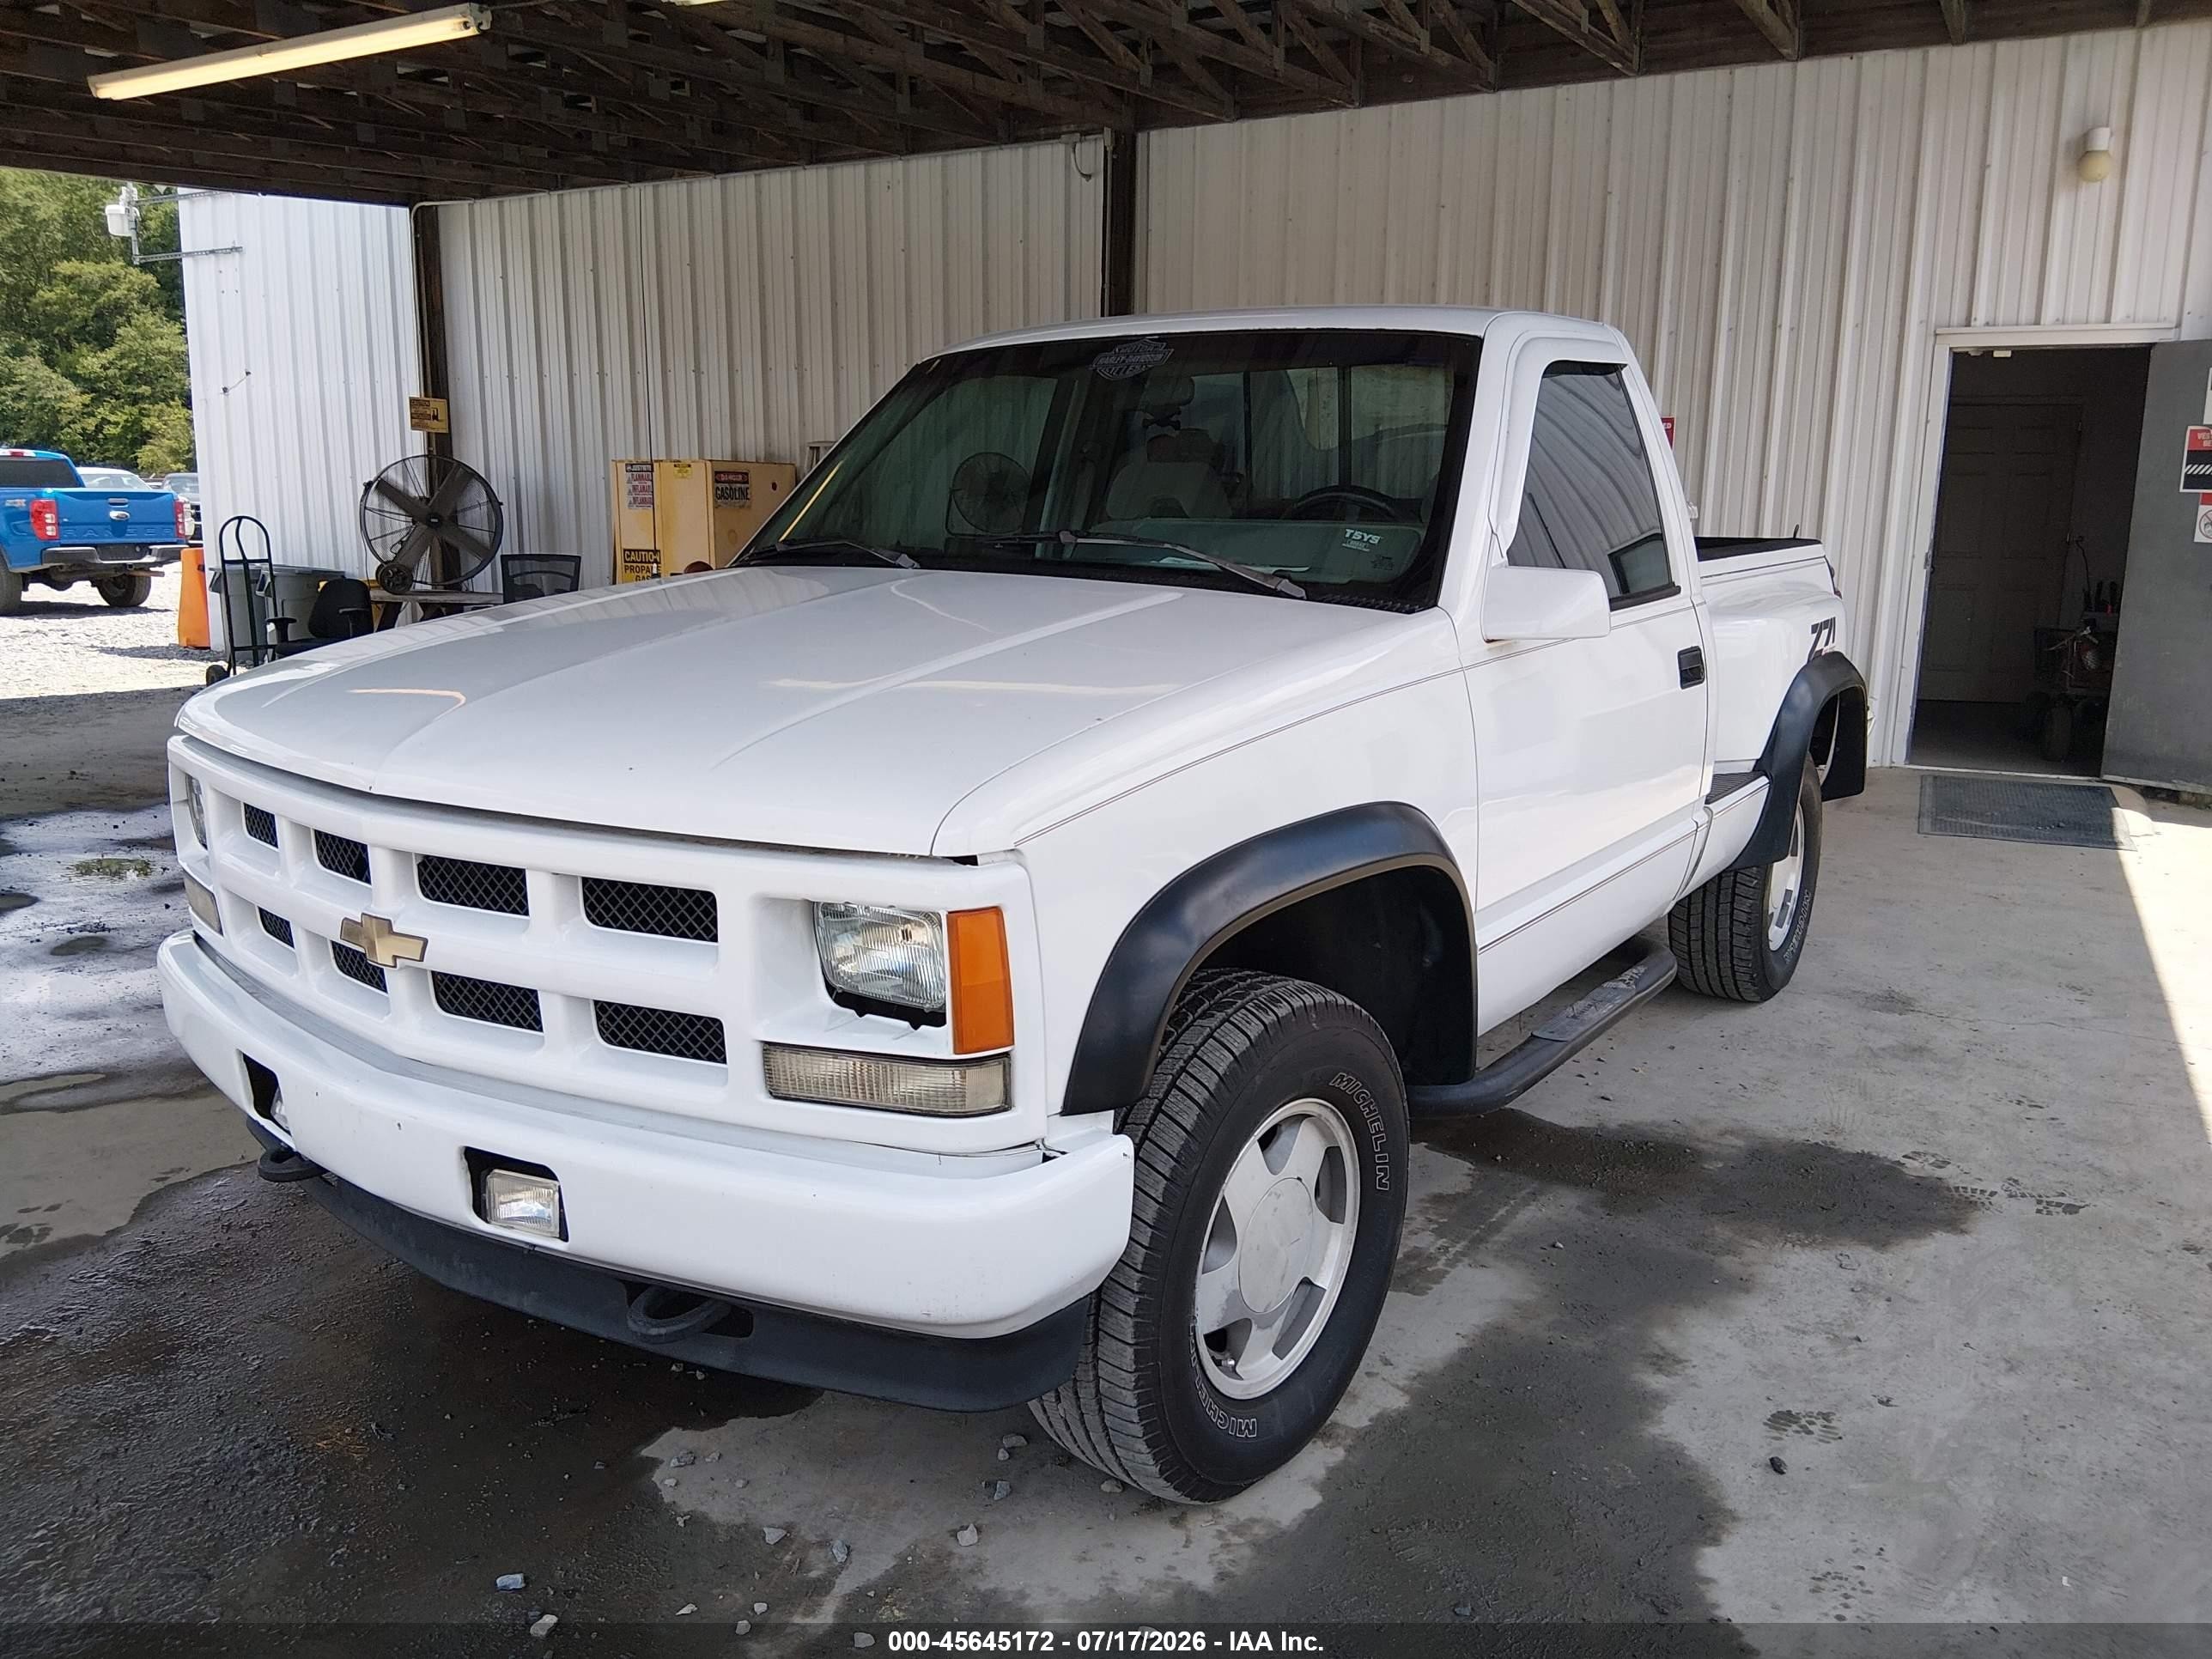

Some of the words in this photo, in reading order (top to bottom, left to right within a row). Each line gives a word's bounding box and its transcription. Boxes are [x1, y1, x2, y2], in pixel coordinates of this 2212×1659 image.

[715, 486, 750, 500] GASOLINE
[624, 550, 659, 562] CAUTION
[624, 564, 661, 574] PROPAE
[1328, 1072, 1389, 1191] MICHELIN
